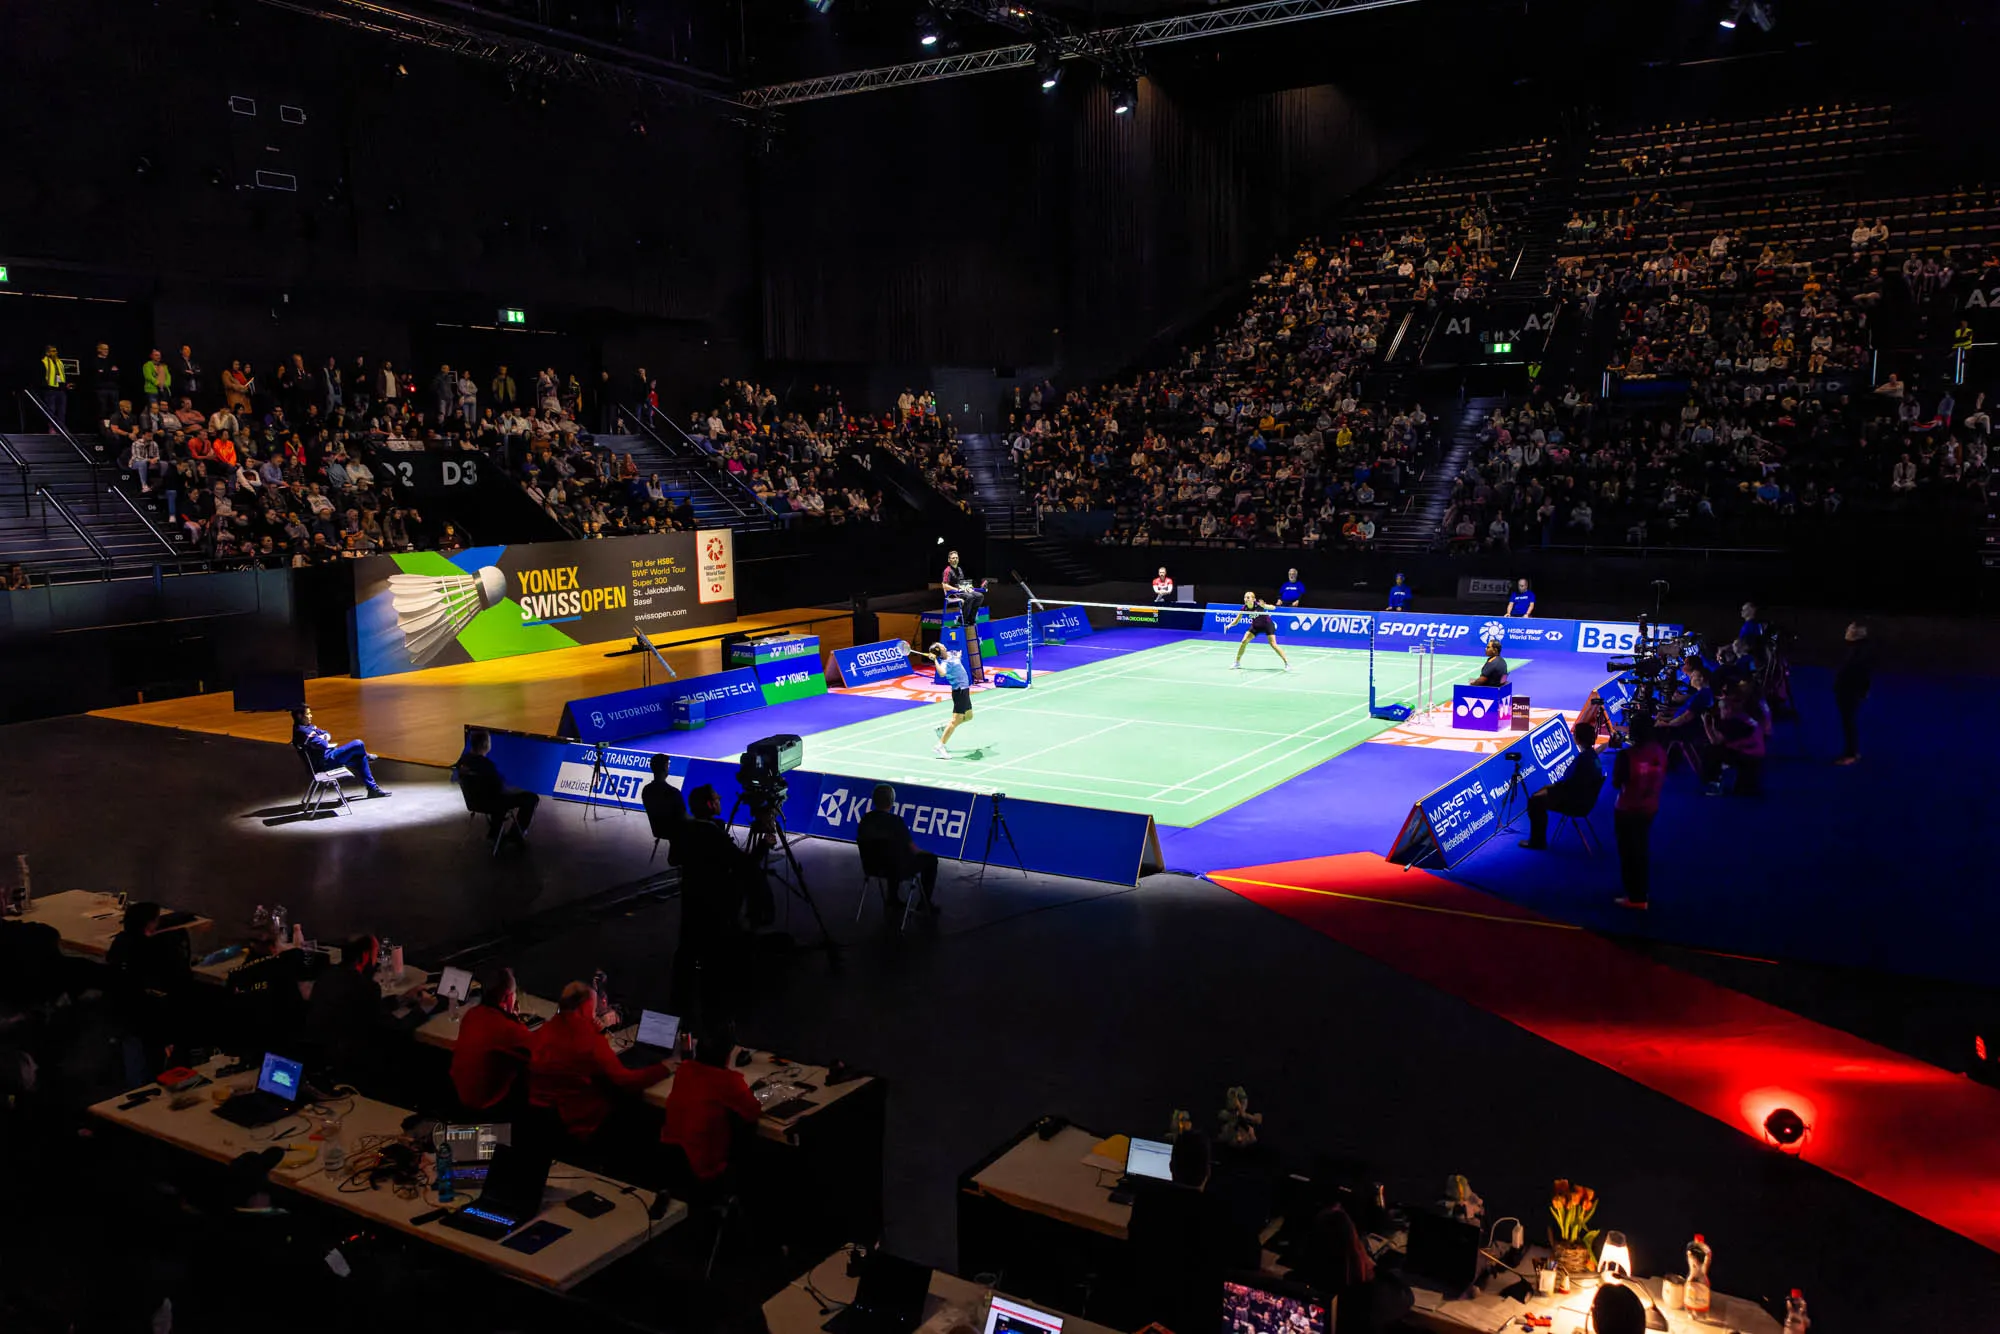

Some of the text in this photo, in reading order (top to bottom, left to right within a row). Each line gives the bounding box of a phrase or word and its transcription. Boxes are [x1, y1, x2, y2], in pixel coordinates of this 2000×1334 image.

[1445, 316, 1471, 335] A1
[442, 460, 478, 486] D3
[631, 556, 675, 568] Teil der HSBC
[632, 566, 686, 578] BWF World Tour
[517, 566, 580, 595] YONEX
[632, 576, 668, 588] Super 300
[633, 588, 643, 597] St.
[633, 597, 653, 606] Basel
[634, 608, 687, 622] swissopen.com
[1320, 616, 1371, 634] YONEX
[783, 643, 805, 656] YONEX
[787, 671, 810, 685] YONEX
[607, 702, 662, 721] VICTORINOX
[1535, 728, 1568, 760] BASILISK
[1428, 781, 1483, 823] MARKETING
